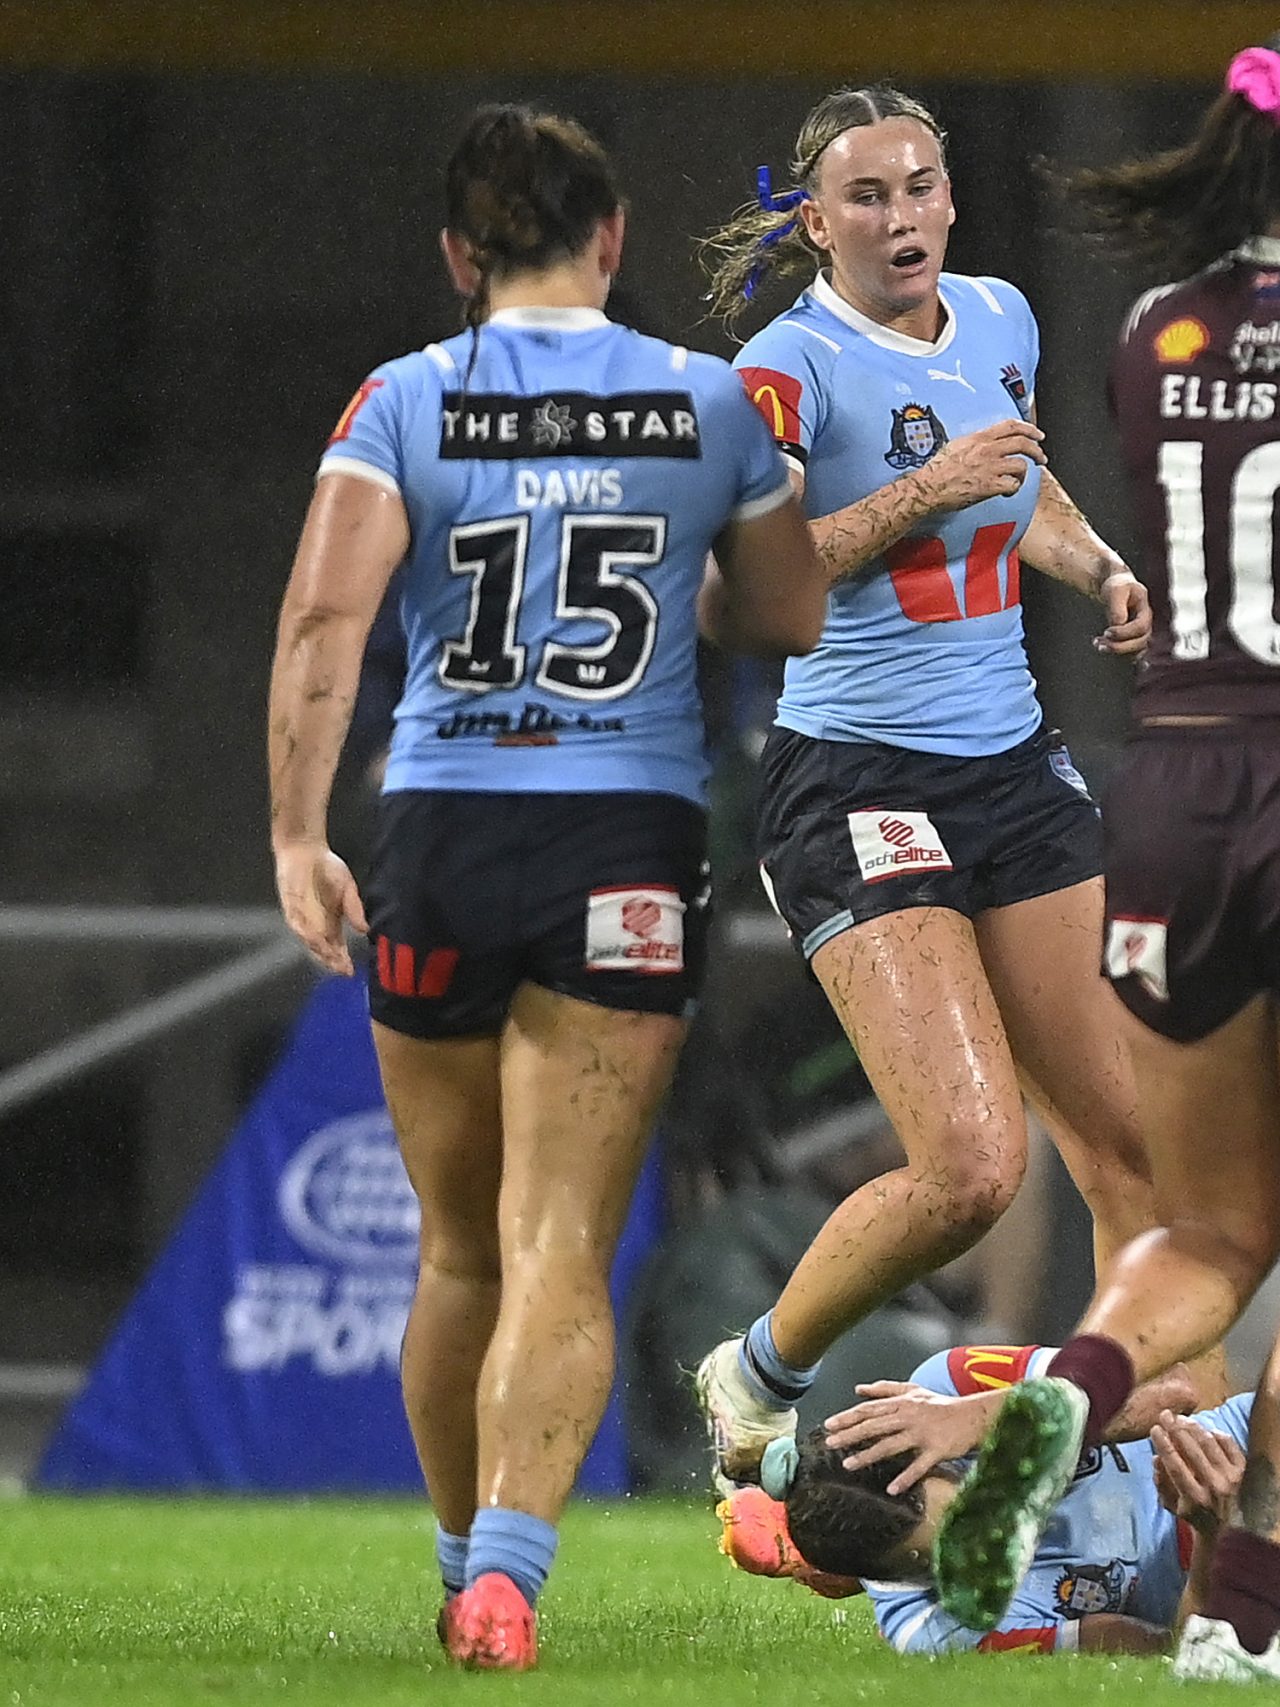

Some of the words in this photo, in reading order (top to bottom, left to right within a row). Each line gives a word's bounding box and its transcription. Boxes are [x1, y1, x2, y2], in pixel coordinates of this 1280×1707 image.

[444, 411, 519, 441] THE
[584, 411, 697, 441] STAR
[515, 469, 625, 507] DAVIS
[438, 514, 667, 701] 15
